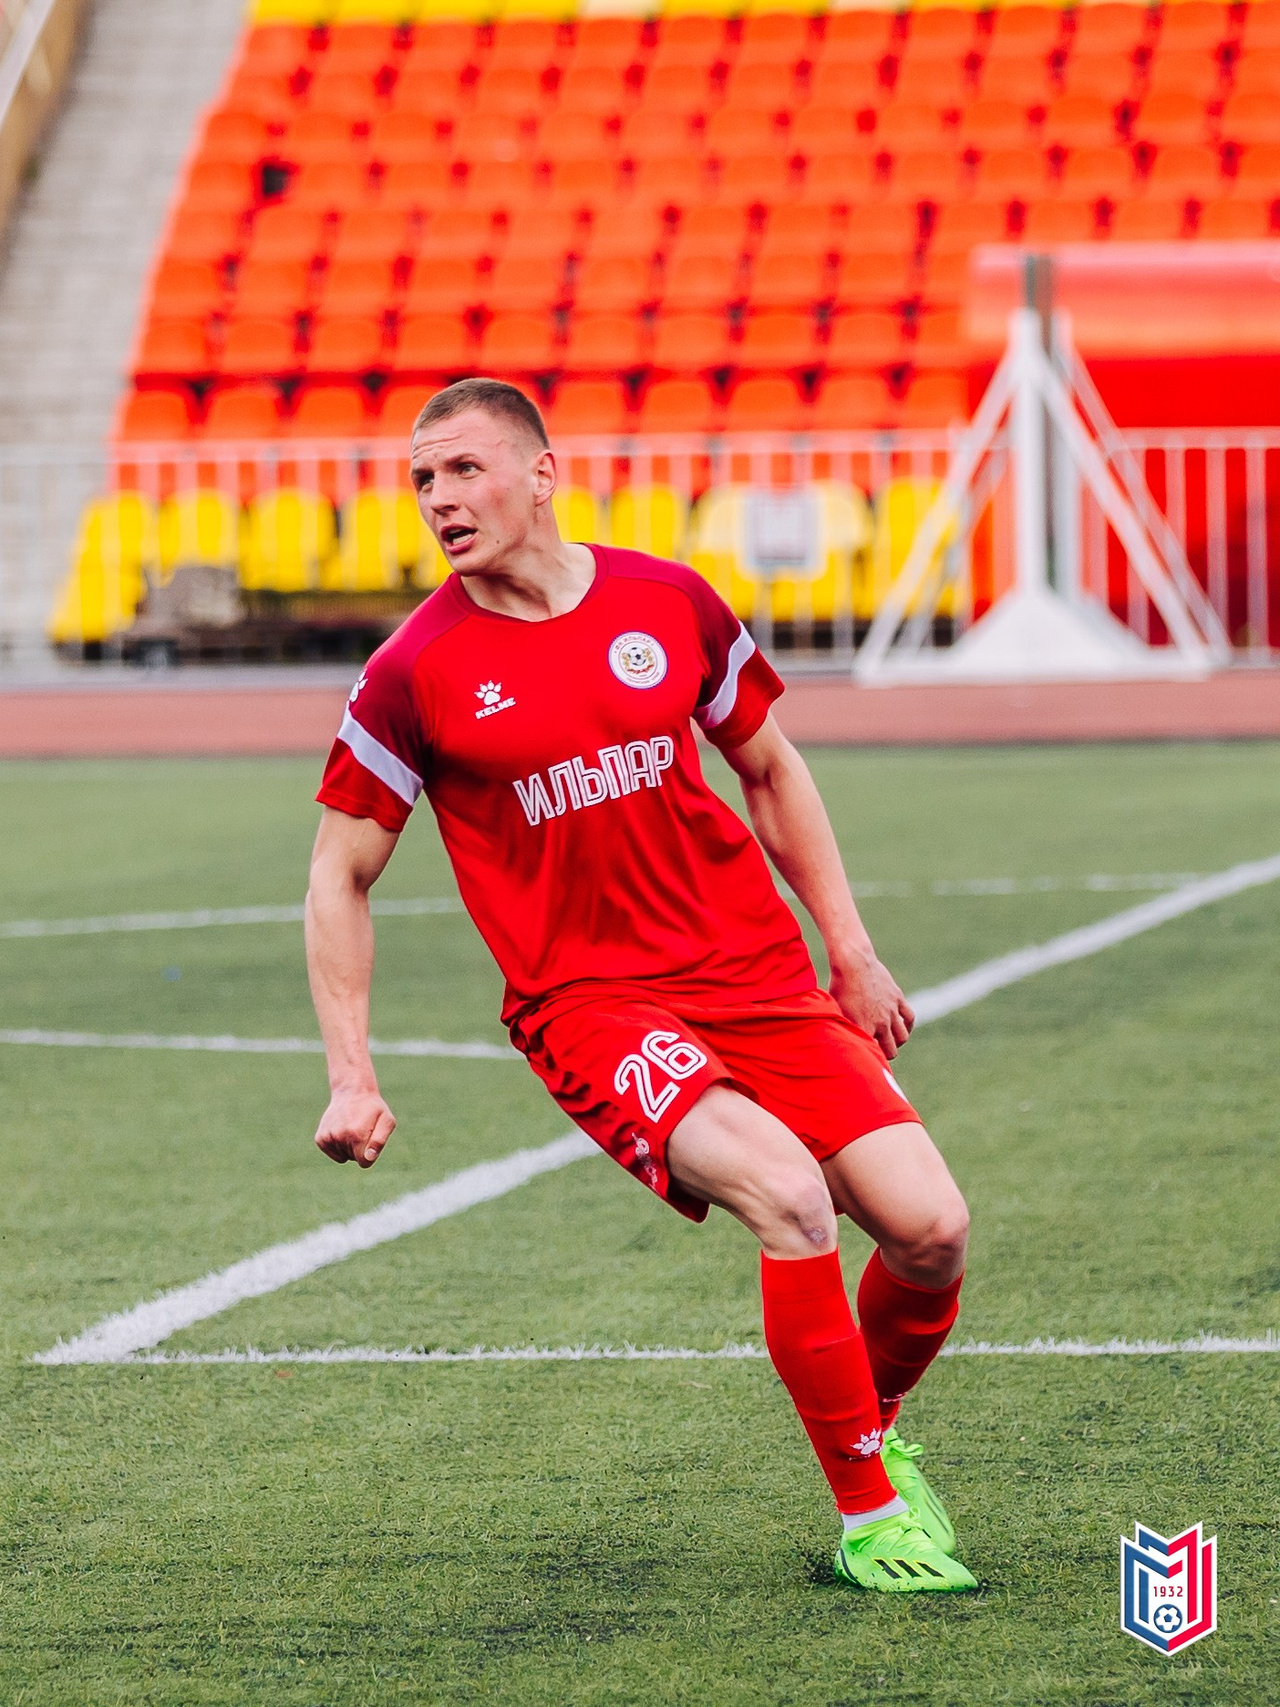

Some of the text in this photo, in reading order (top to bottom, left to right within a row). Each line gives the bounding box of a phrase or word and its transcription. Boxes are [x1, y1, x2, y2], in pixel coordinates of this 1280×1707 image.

[475, 697, 516, 720] KELME
[512, 735, 674, 827] ИЛЬПАР
[614, 1029, 708, 1124] 26
